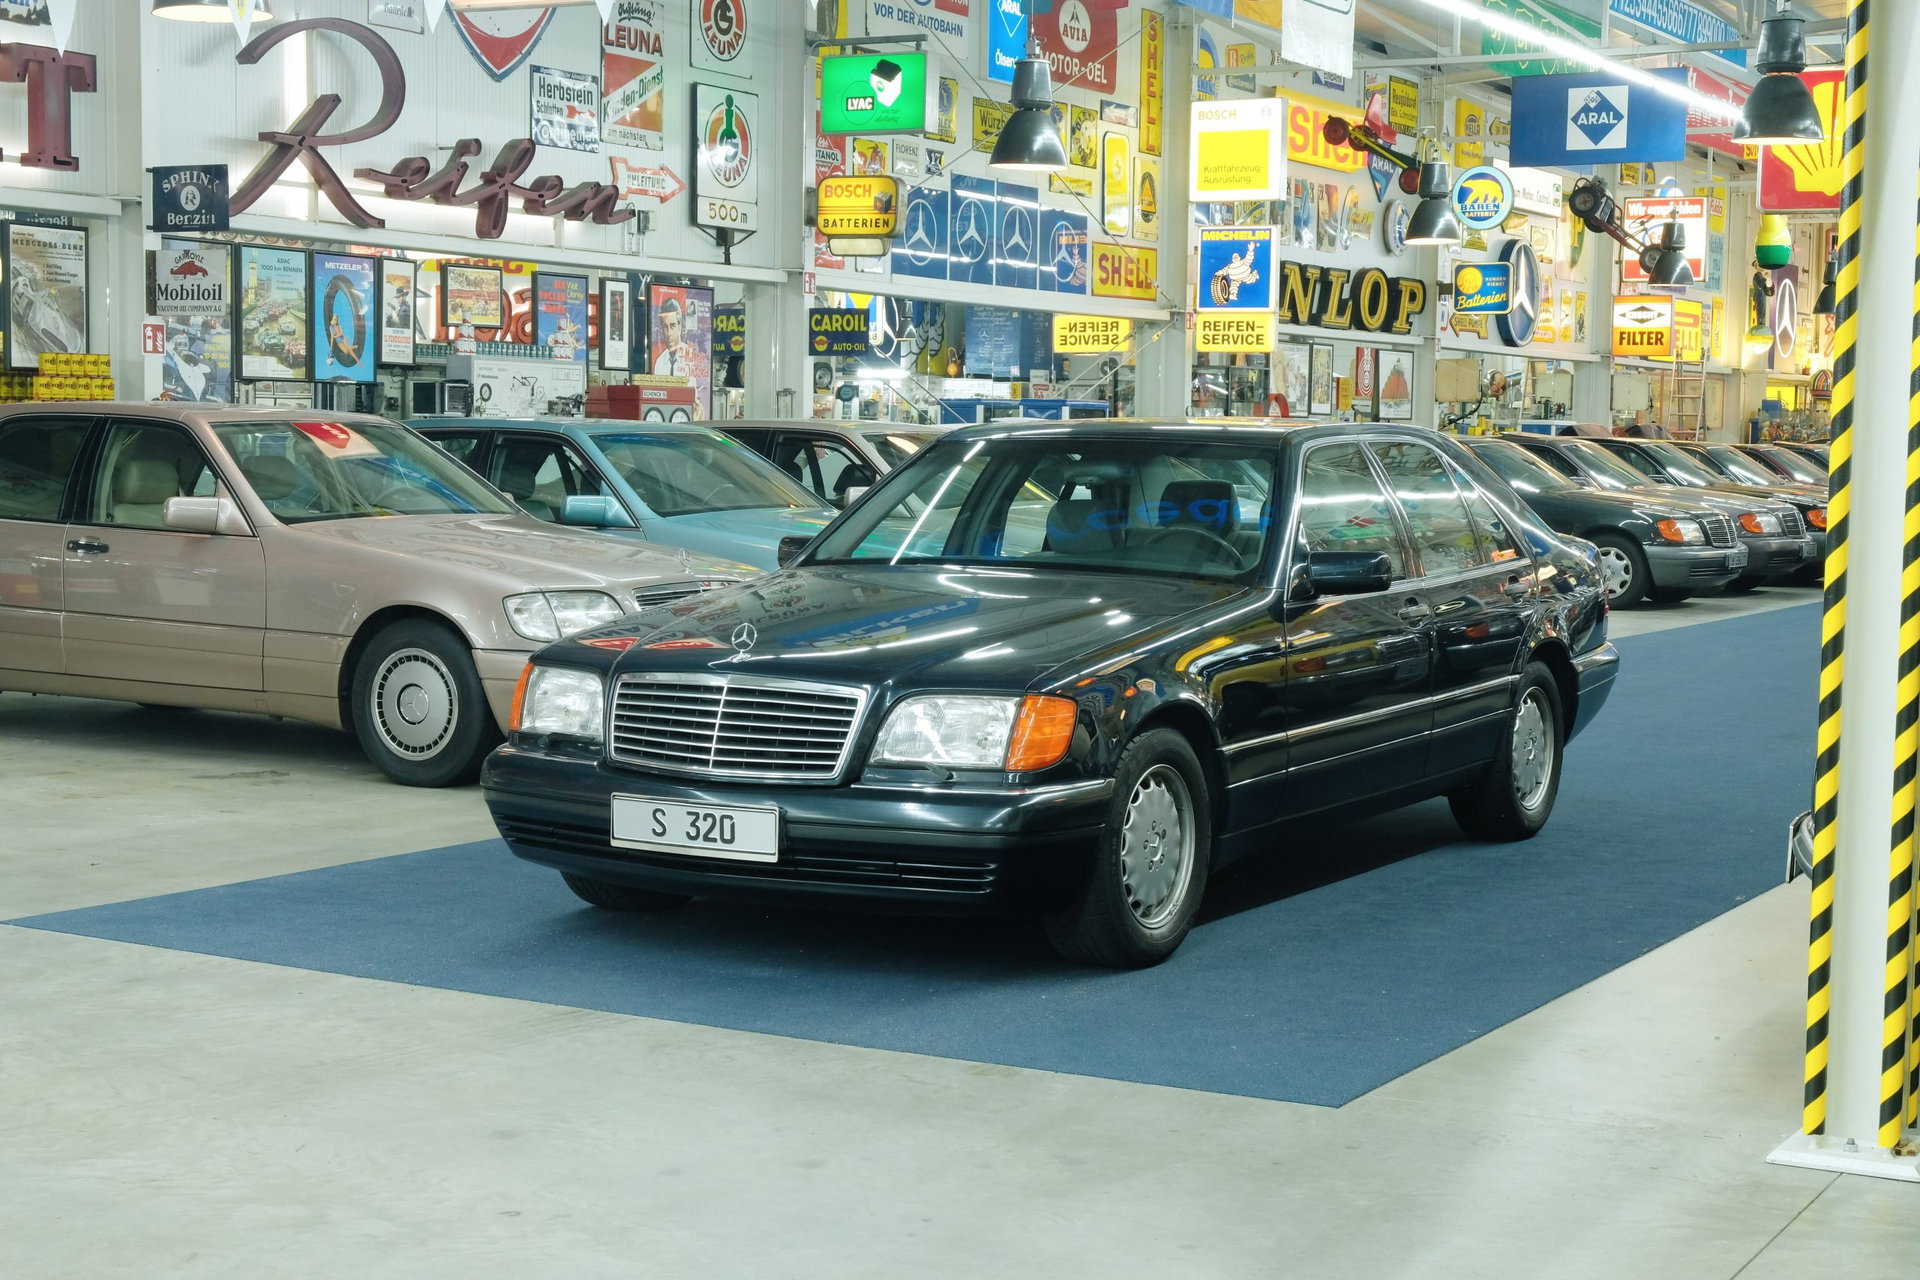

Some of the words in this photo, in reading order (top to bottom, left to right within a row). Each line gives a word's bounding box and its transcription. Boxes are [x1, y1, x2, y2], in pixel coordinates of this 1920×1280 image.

[874, 2, 894, 19] VOR
[897, 8, 915, 25] DER
[918, 14, 963, 37] AUTOBAHN
[603, 24, 664, 57] LEUNA
[704, 23, 743, 56] LEUNA
[1062, 25, 1088, 42] AVIA
[539, 76, 594, 106] Herbstein
[1146, 14, 1159, 151] SHELL
[847, 97, 873, 111] LYAC
[1198, 109, 1236, 121] BOSCH
[1577, 111, 1618, 126] ARAL
[228, 17, 636, 239] Reifen
[895, 143, 919, 156] FLORENZ
[627, 173, 666, 191] UMLEITUNG
[824, 184, 872, 198] BOSCH
[167, 211, 217, 226] Benzin
[708, 202, 739, 222] 500
[740, 211, 748, 223] m
[823, 218, 890, 228] BATTERIEN
[1203, 231, 1270, 241] MICHELIN
[324, 262, 362, 271] METZELER
[1098, 252, 1154, 290] SHELL
[156, 283, 222, 301] Mobiloil
[1279, 259, 1427, 335] NLOP
[1456, 291, 1507, 309] Batterien
[811, 313, 867, 332] CAROIL
[1203, 321, 1264, 332] REIFEN-
[832, 342, 866, 351] AUTO-OIL
[1202, 334, 1265, 345] SERVICE
[1619, 331, 1664, 346] FILTER
[651, 807, 667, 838] S
[685, 810, 736, 845] 320
